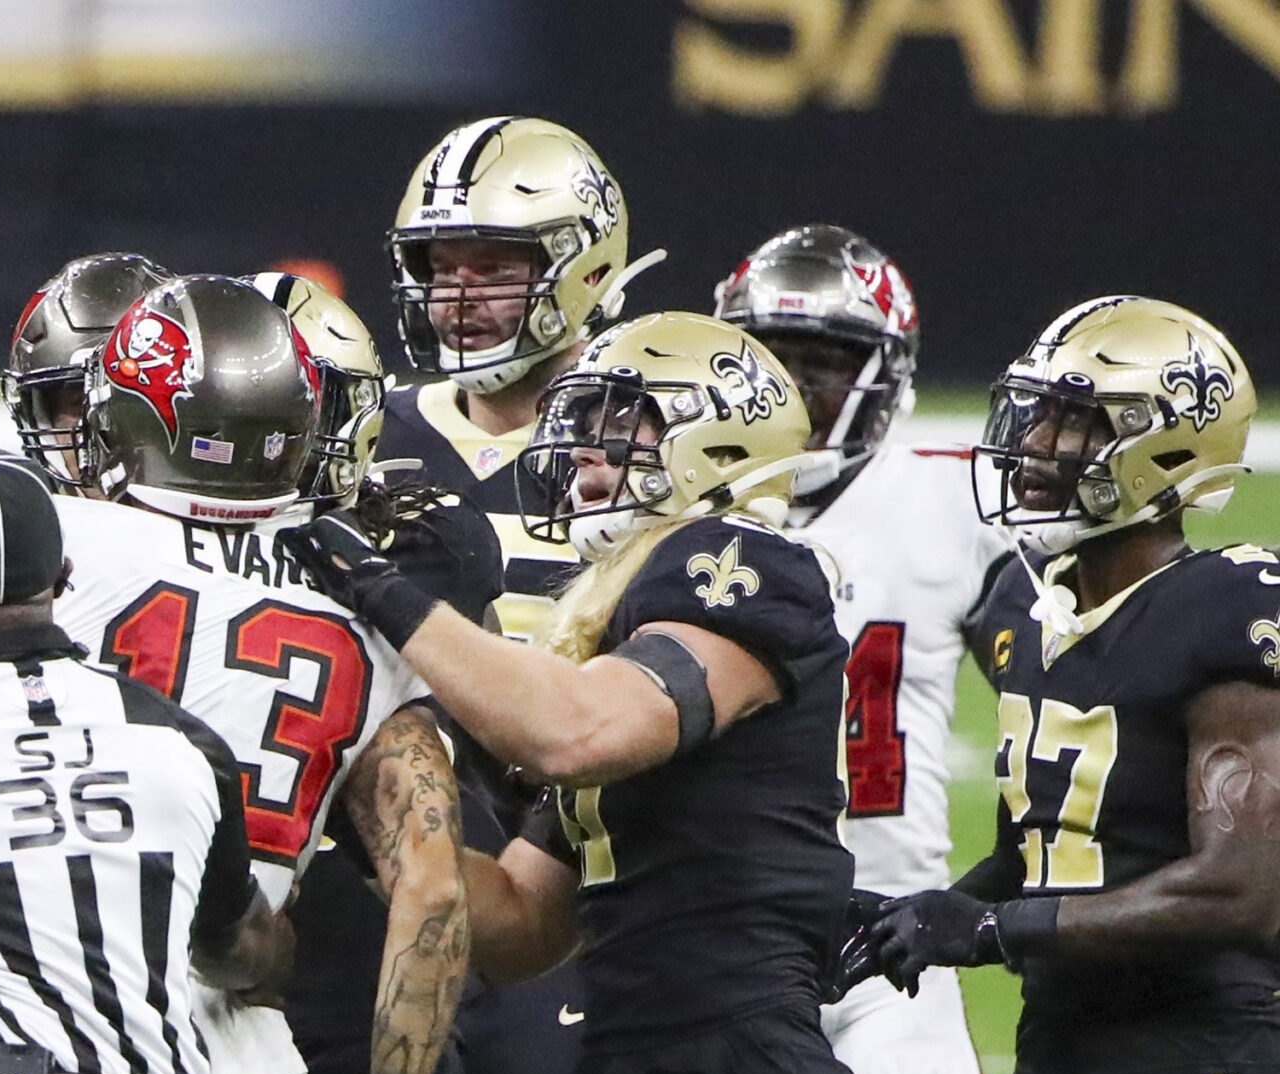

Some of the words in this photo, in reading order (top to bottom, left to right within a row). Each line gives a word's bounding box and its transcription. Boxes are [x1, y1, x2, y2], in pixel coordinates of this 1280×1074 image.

[421, 208, 451, 220] SAINTS
[99, 579, 374, 871] 13
[14, 728, 94, 773] SJ
